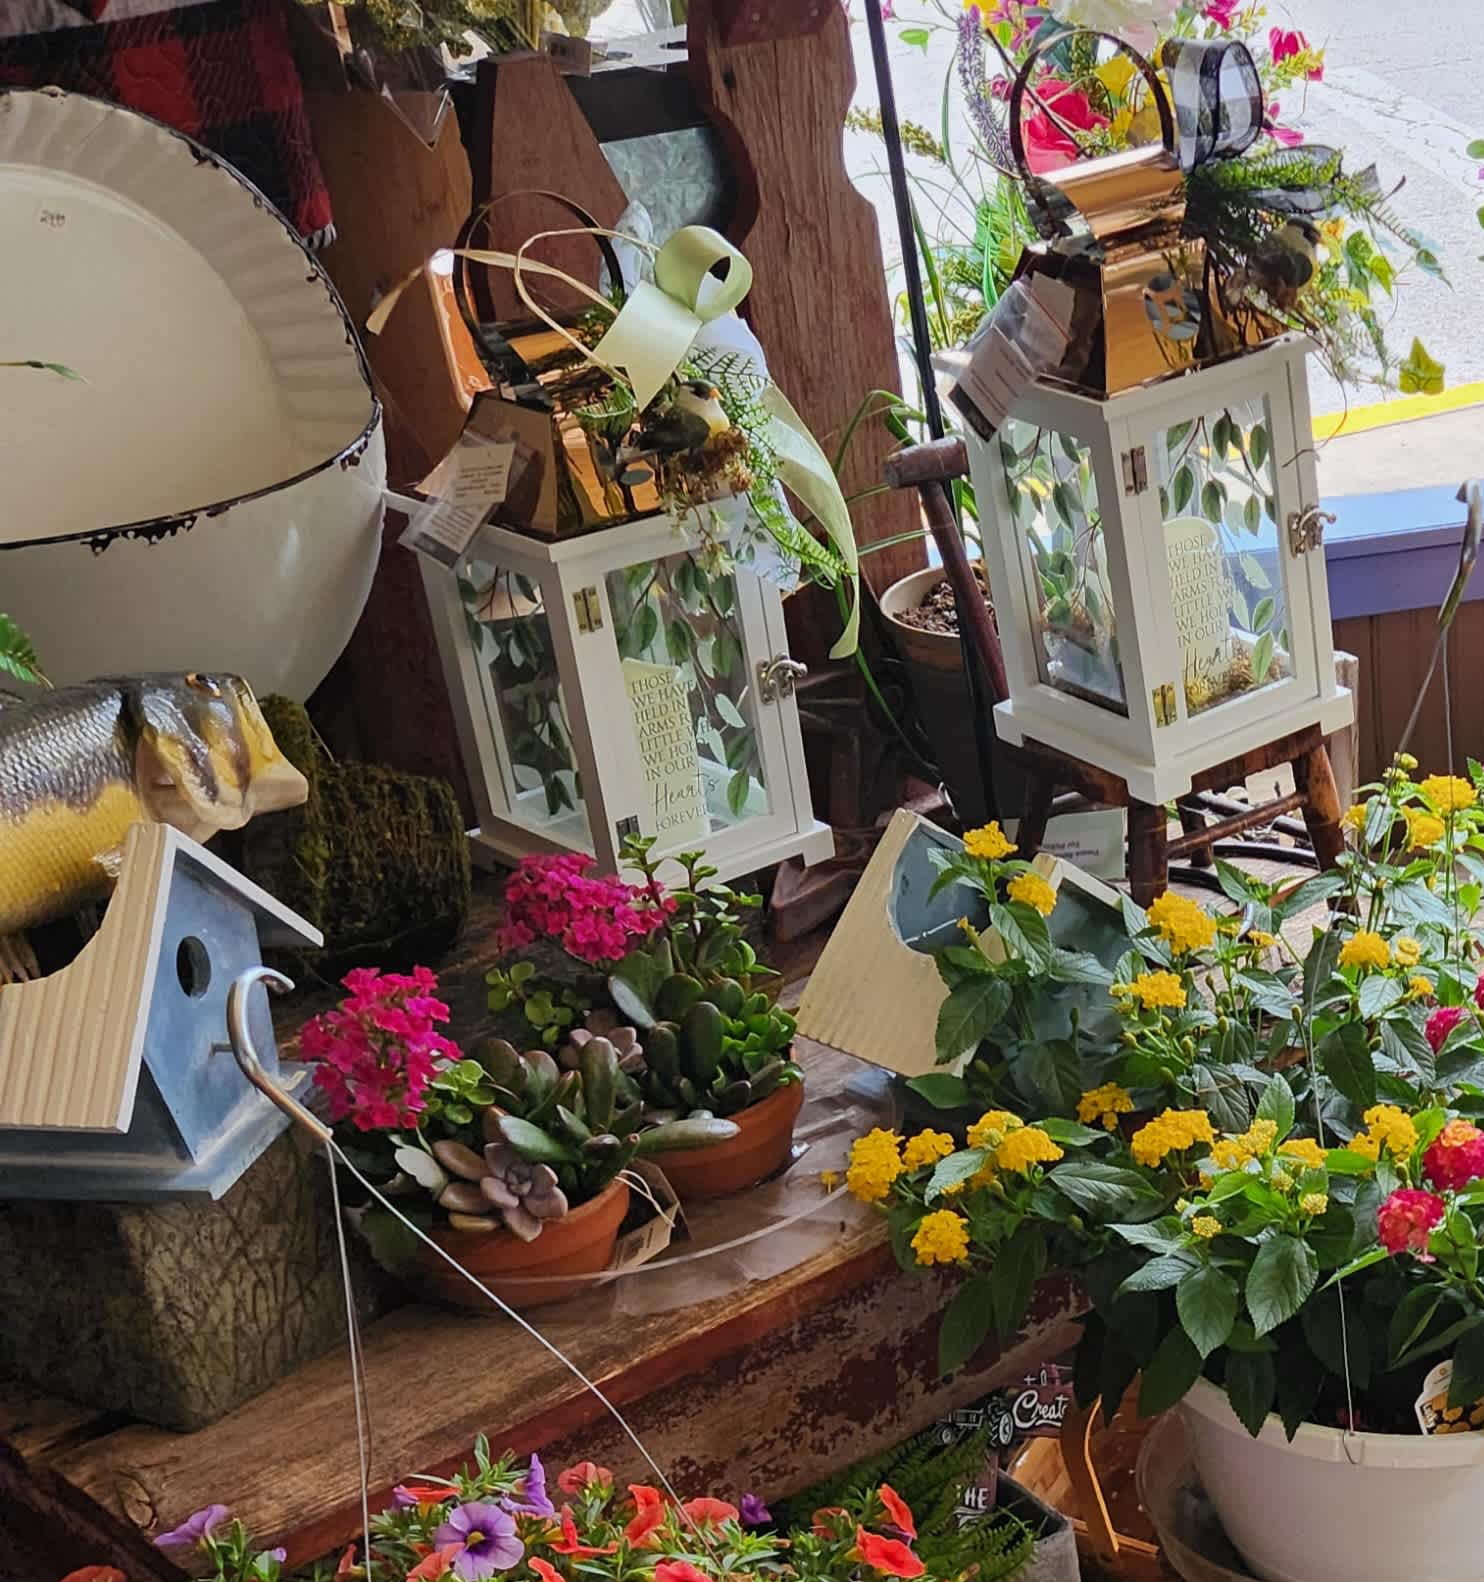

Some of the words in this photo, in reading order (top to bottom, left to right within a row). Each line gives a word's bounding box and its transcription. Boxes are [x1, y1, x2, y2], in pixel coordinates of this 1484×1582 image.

[631, 671, 672, 695] THOSE
[632, 693, 655, 709] WE
[635, 702, 668, 725] HELD
[640, 716, 676, 738] ARMS
[640, 729, 681, 754] LITTLE
[642, 751, 666, 767] WE
[646, 765, 661, 781] IN
[664, 754, 697, 775] OUR
